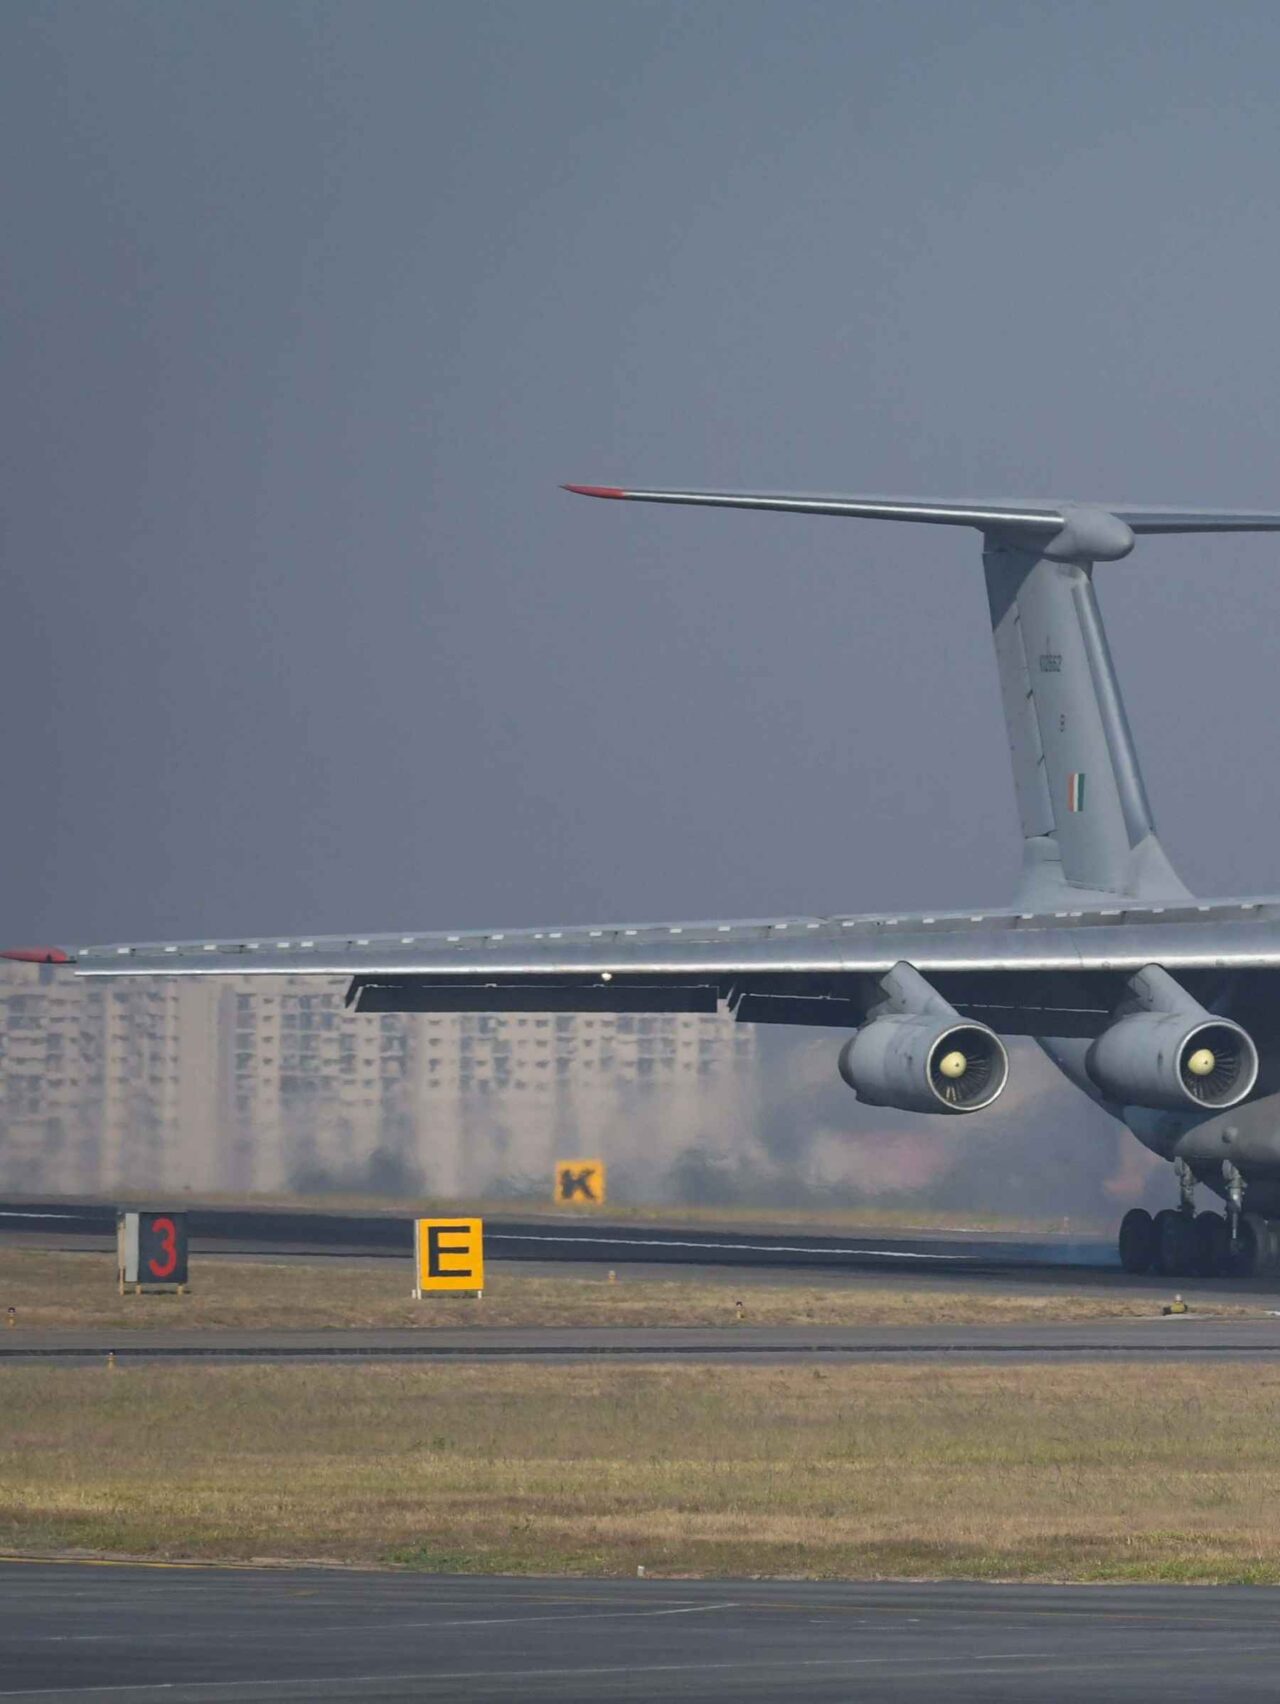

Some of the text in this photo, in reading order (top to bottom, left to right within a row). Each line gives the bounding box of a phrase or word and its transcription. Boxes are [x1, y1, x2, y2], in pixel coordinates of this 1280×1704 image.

[560, 1168, 596, 1200] K
[149, 1216, 177, 1277] 3
[427, 1226, 472, 1277] E
